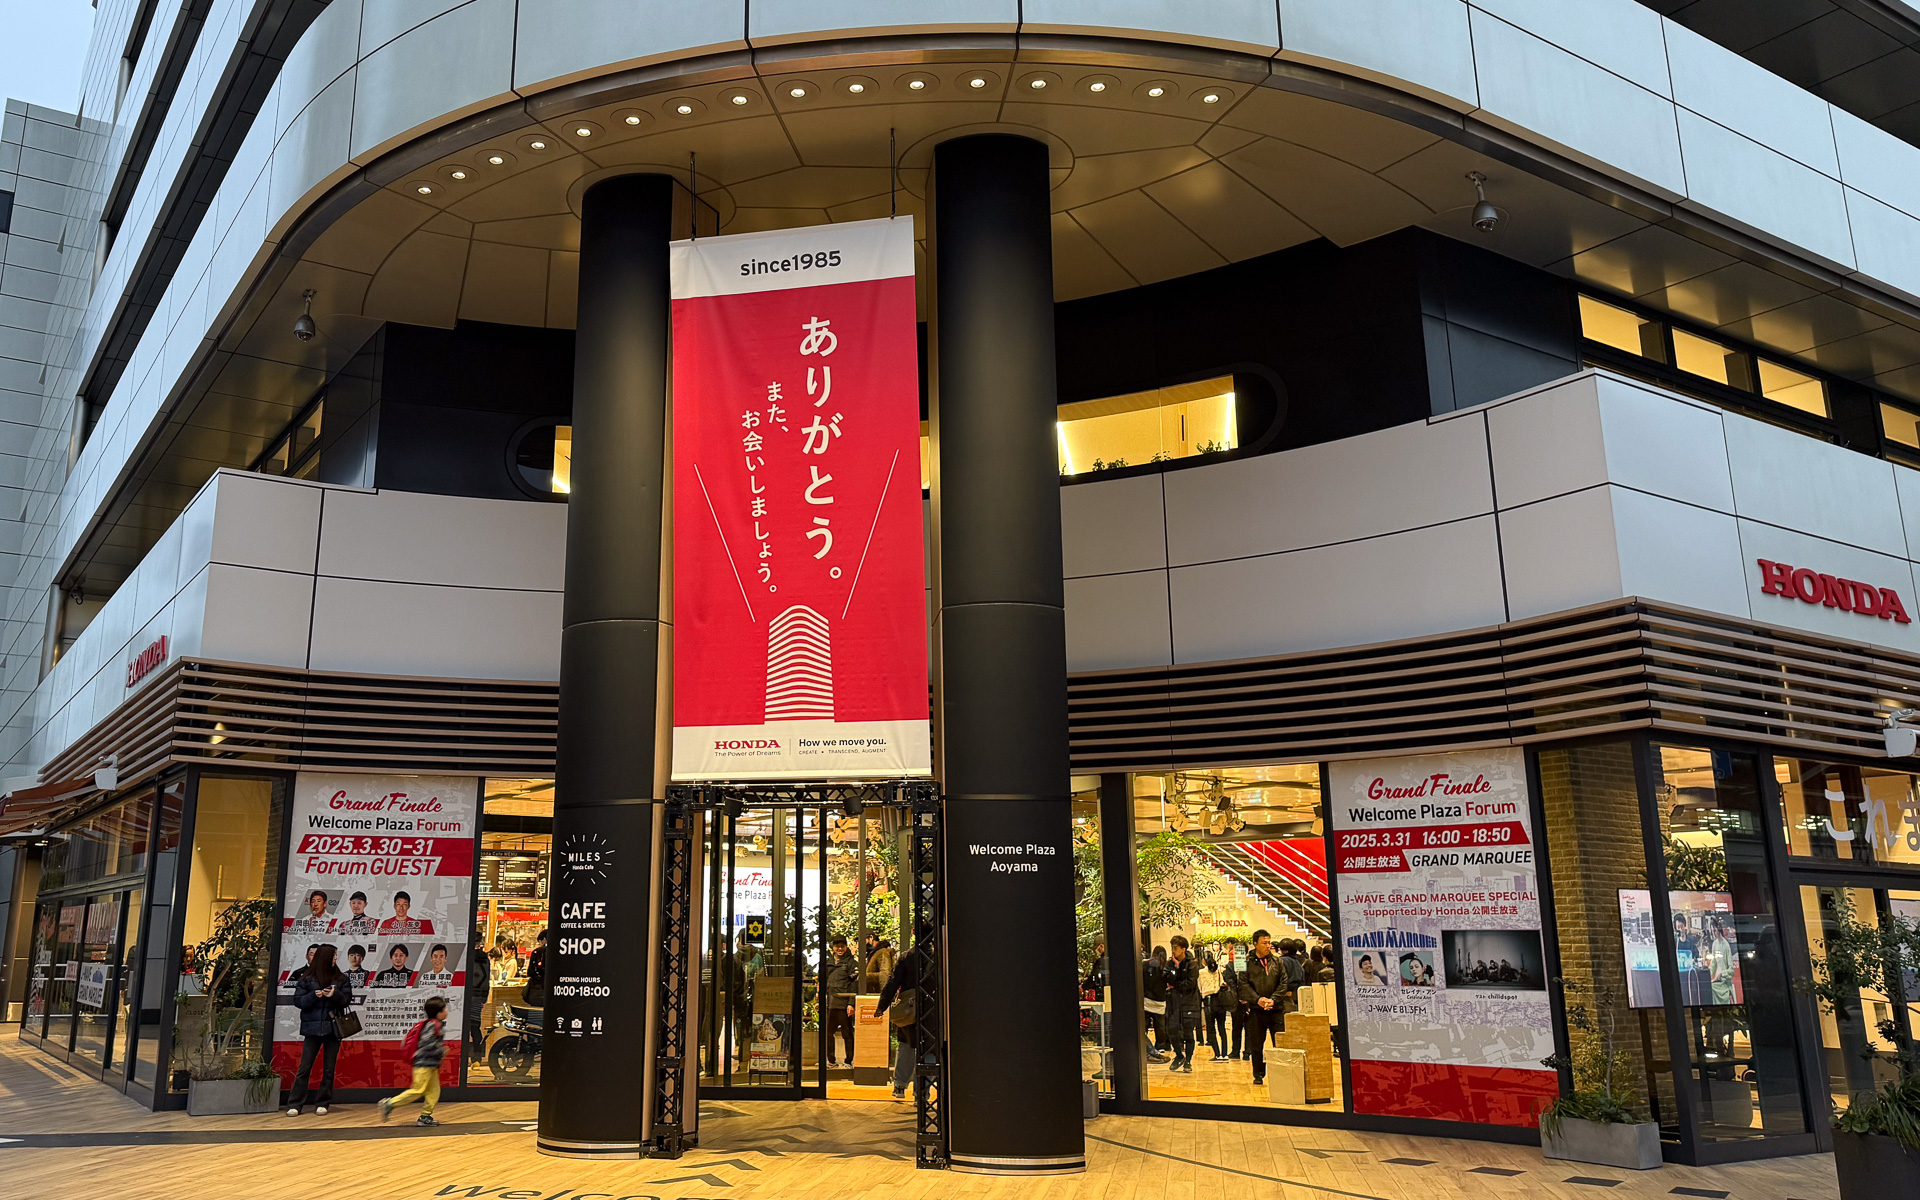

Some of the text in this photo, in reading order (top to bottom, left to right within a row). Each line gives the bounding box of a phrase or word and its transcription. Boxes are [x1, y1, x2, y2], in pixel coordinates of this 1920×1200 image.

[740, 250, 842, 276] since1985
[767, 381, 789, 432] また、
[799, 316, 844, 579] ありがとう。
[741, 410, 777, 593] お会いしましょう。
[1757, 558, 1912, 624] HONDA
[714, 739, 781, 750] HONDA
[799, 738, 820, 747] How
[866, 738, 887, 747] you.
[1368, 773, 1492, 800] Grand Finale
[329, 790, 443, 813] Grand Finale
[1348, 801, 1516, 822] Welcome Plaza Forum
[308, 815, 461, 832] Welcome Plaza Forum
[305, 836, 434, 856] 2025.3.30-31
[1341, 832, 1411, 848] 2025.3.31
[1422, 830, 1461, 845] 16:00
[1472, 827, 1511, 843] 18:50
[568, 852, 601, 862] MILES
[969, 844, 1056, 856] Welcome Plaza
[305, 856, 437, 876] Forum GUEST
[990, 861, 1038, 874] Aoyama
[1343, 851, 1532, 869] 公開生放送 GRAND MARQUEE
[1344, 891, 1536, 904] J-WAVE GRAND MARQUEE SPECIAL
[561, 902, 606, 919] CAFE
[1363, 905, 1519, 918] supported by Honda 公開生放送
[1211, 919, 1249, 927] HONDA
[1347, 927, 1437, 948] GRAND MARQUEE
[559, 938, 606, 955] SHOP
[553, 985, 611, 997] 10:00-18:00
[1368, 1005, 1427, 1014] J-WAVE 81.3FM
